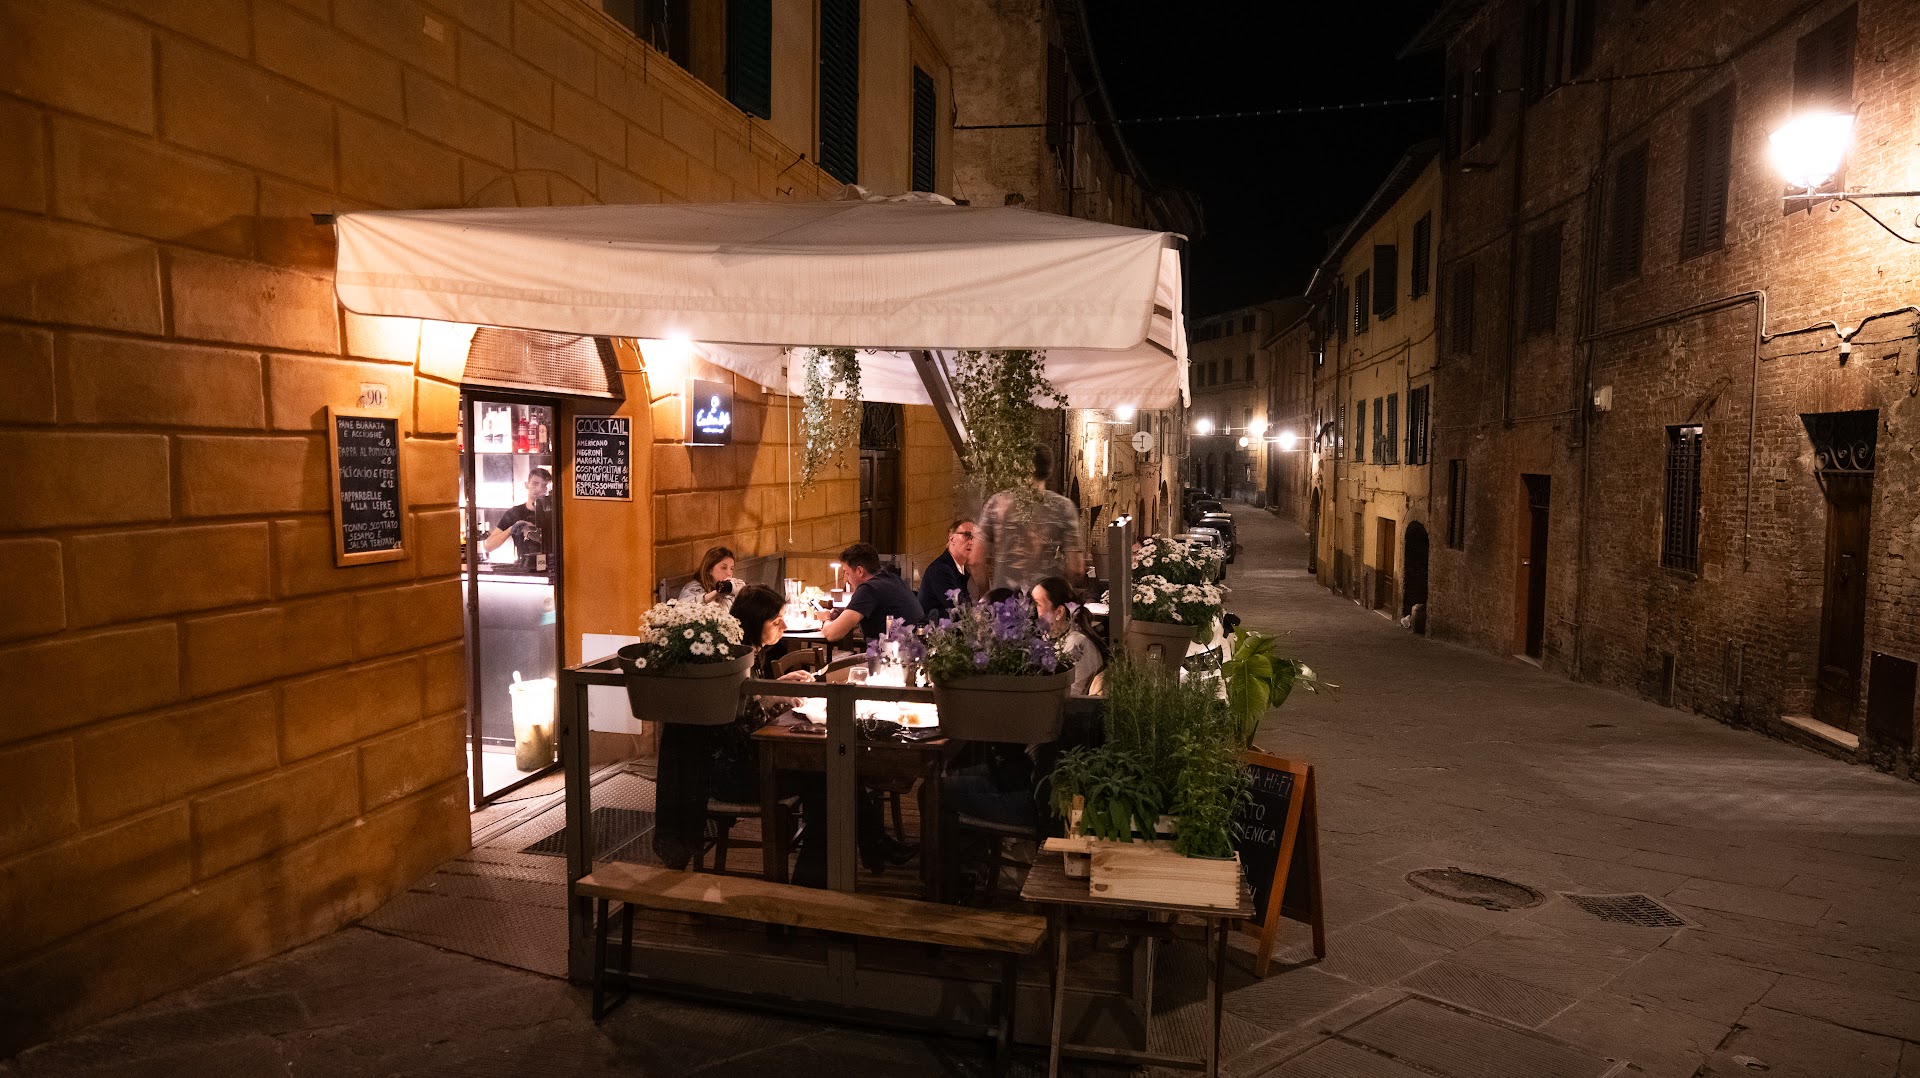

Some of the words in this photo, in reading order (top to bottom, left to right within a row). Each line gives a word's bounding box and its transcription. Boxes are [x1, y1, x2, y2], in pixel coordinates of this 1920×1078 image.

[367, 390, 382, 405] 90
[338, 420, 354, 429] PANE
[355, 421, 386, 430] BURRATA
[576, 418, 629, 434] COCKTAIL
[344, 430, 348, 438] E
[352, 429, 382, 438] ACCIUGHE
[577, 439, 608, 447] AMERICANO
[338, 446, 357, 457] PAPPA
[360, 447, 367, 457] AL
[577, 448, 603, 457] NEGRONI
[576, 457, 613, 465] MARGARITA
[352, 466, 373, 478] CACIO
[373, 469, 378, 478] E
[379, 469, 395, 479] PEPE
[576, 465, 622, 474] COSMOPOLITAN
[576, 473, 601, 482] MOSCOW
[602, 474, 619, 483] MULE
[340, 490, 382, 502] PAPPARDELLE
[350, 502, 368, 511] ALLA
[372, 500, 392, 511] LEPRE
[343, 523, 368, 532] TONNO
[369, 520, 398, 531] SCOTTATO
[348, 531, 375, 541] SESAMO
[377, 530, 382, 539] E
[348, 540, 368, 549] SALSA
